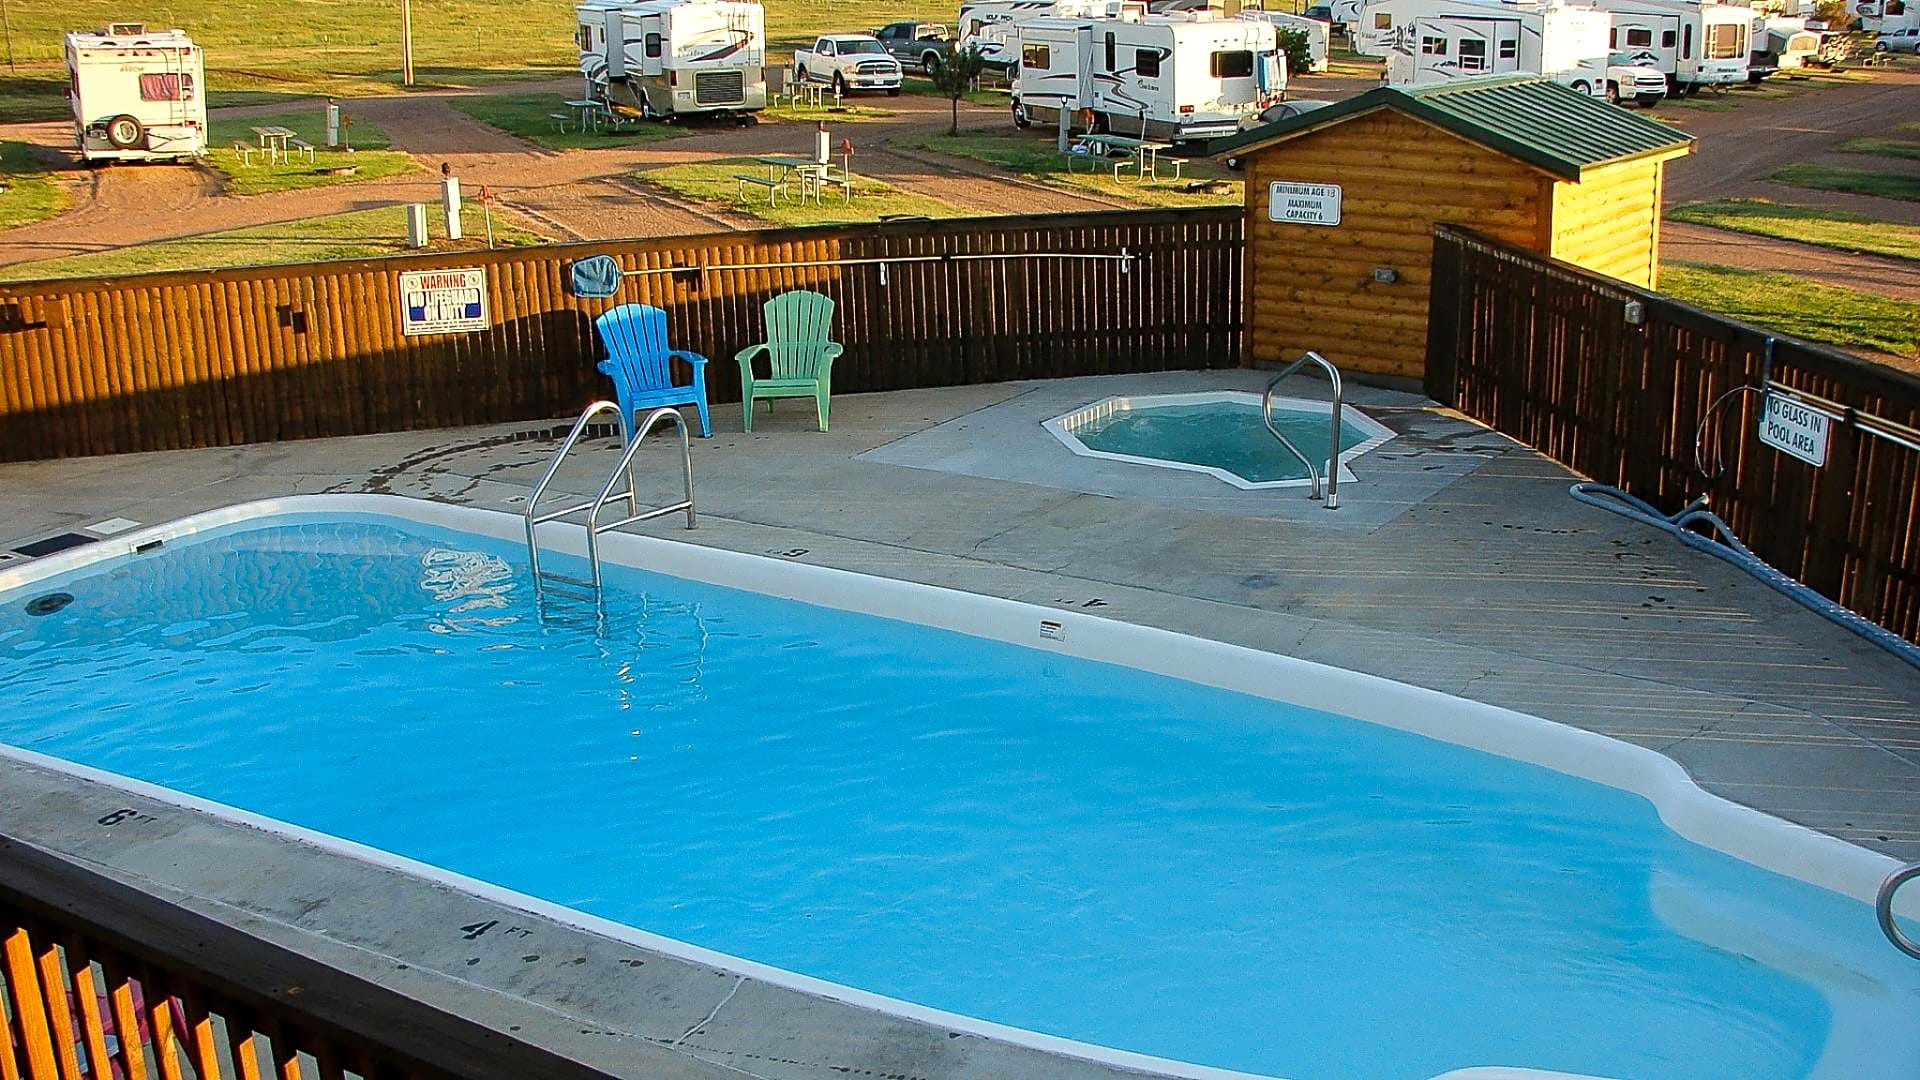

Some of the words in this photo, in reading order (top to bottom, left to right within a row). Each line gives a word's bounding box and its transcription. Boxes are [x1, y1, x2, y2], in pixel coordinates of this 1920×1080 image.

[1276, 185, 1310, 196] MINIMUM
[1311, 188, 1325, 197] AGE
[1287, 198, 1322, 210] MAXIMUM
[1286, 209, 1318, 220] CAPACITY
[1318, 212, 1323, 220] 6
[420, 273, 467, 290] WARNING
[409, 291, 425, 308] NO
[426, 287, 479, 307] LIFEGUARD
[425, 304, 440, 321] ON
[441, 302, 465, 320] DUTY
[1766, 396, 1780, 415] NO
[1781, 404, 1808, 428] GLASS
[1810, 415, 1822, 433] IN
[1767, 420, 1790, 445] POOL
[1791, 432, 1815, 455] AREA
[98, 809, 138, 826] 6
[133, 814, 158, 825] FT
[460, 919, 499, 940] 4
[503, 926, 534, 939] FT
